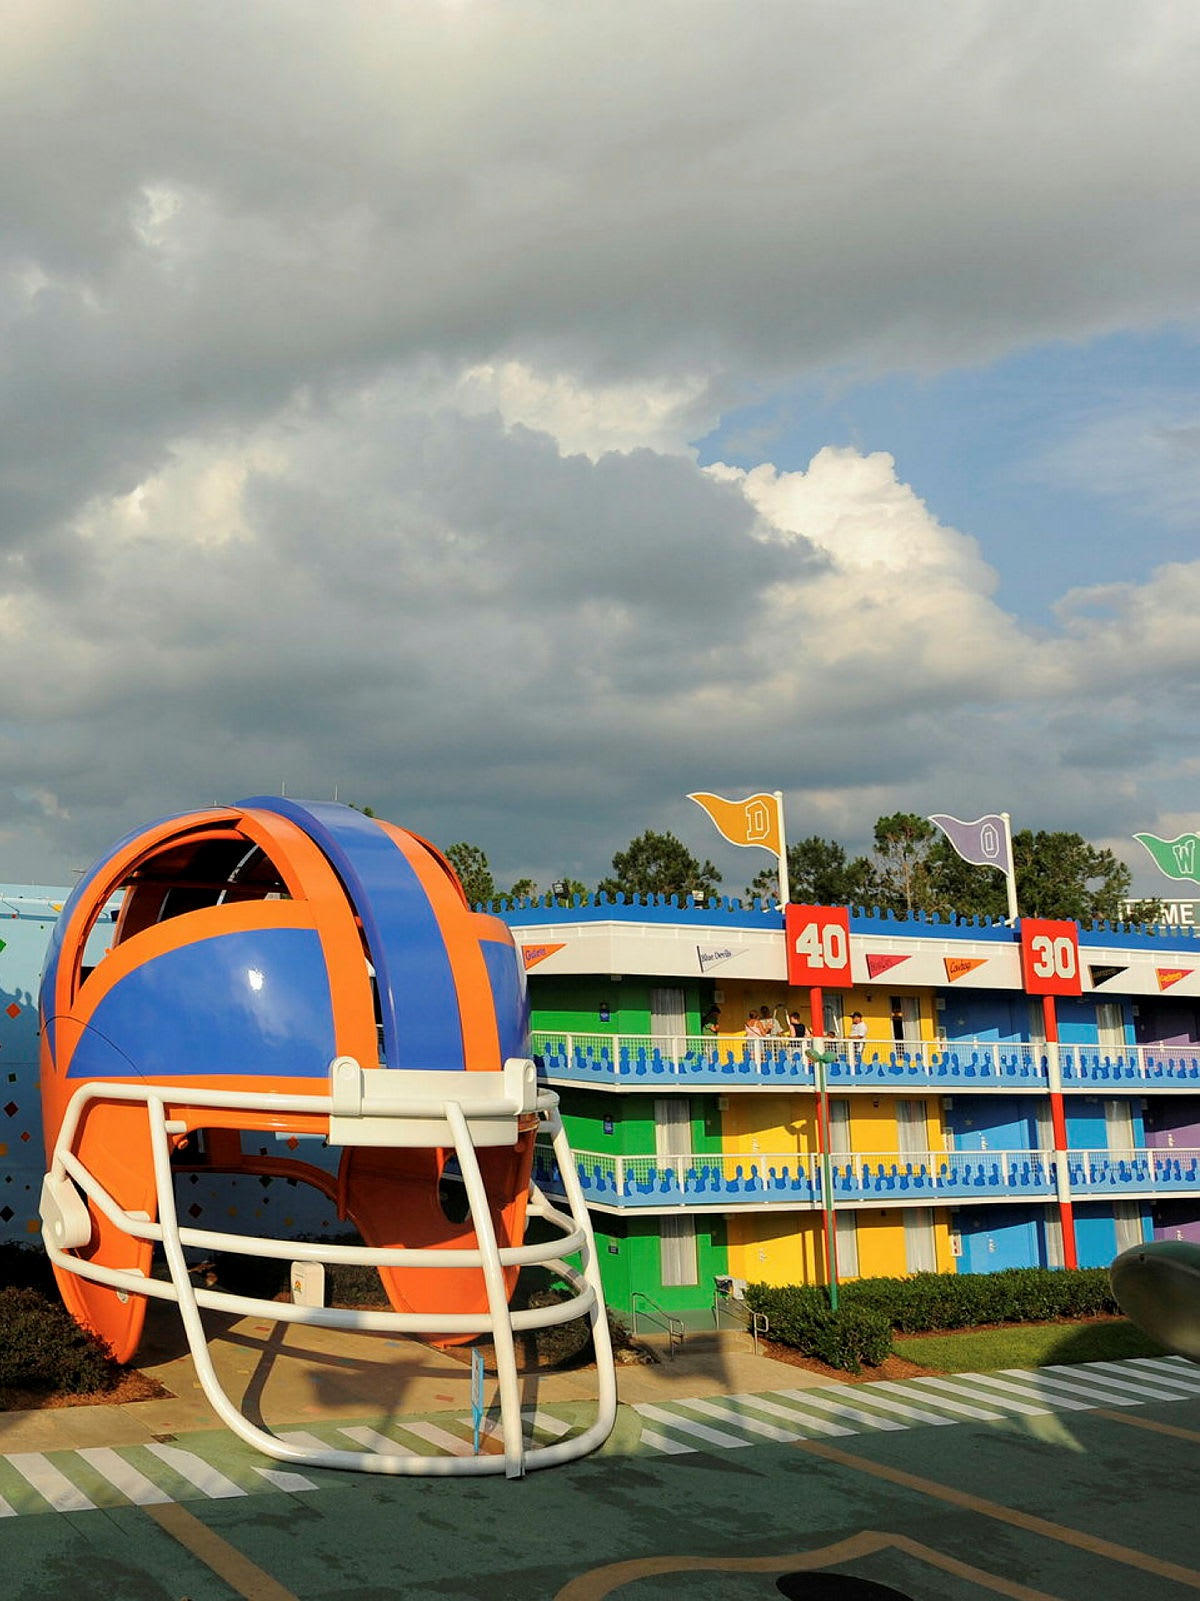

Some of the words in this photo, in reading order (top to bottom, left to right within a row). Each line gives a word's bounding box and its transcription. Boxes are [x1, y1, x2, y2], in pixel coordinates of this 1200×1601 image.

[745, 800, 770, 841] D
[1172, 839, 1196, 875] W
[1126, 902, 1196, 925] ME
[795, 923, 848, 970] 40
[1031, 935, 1076, 979] 30
